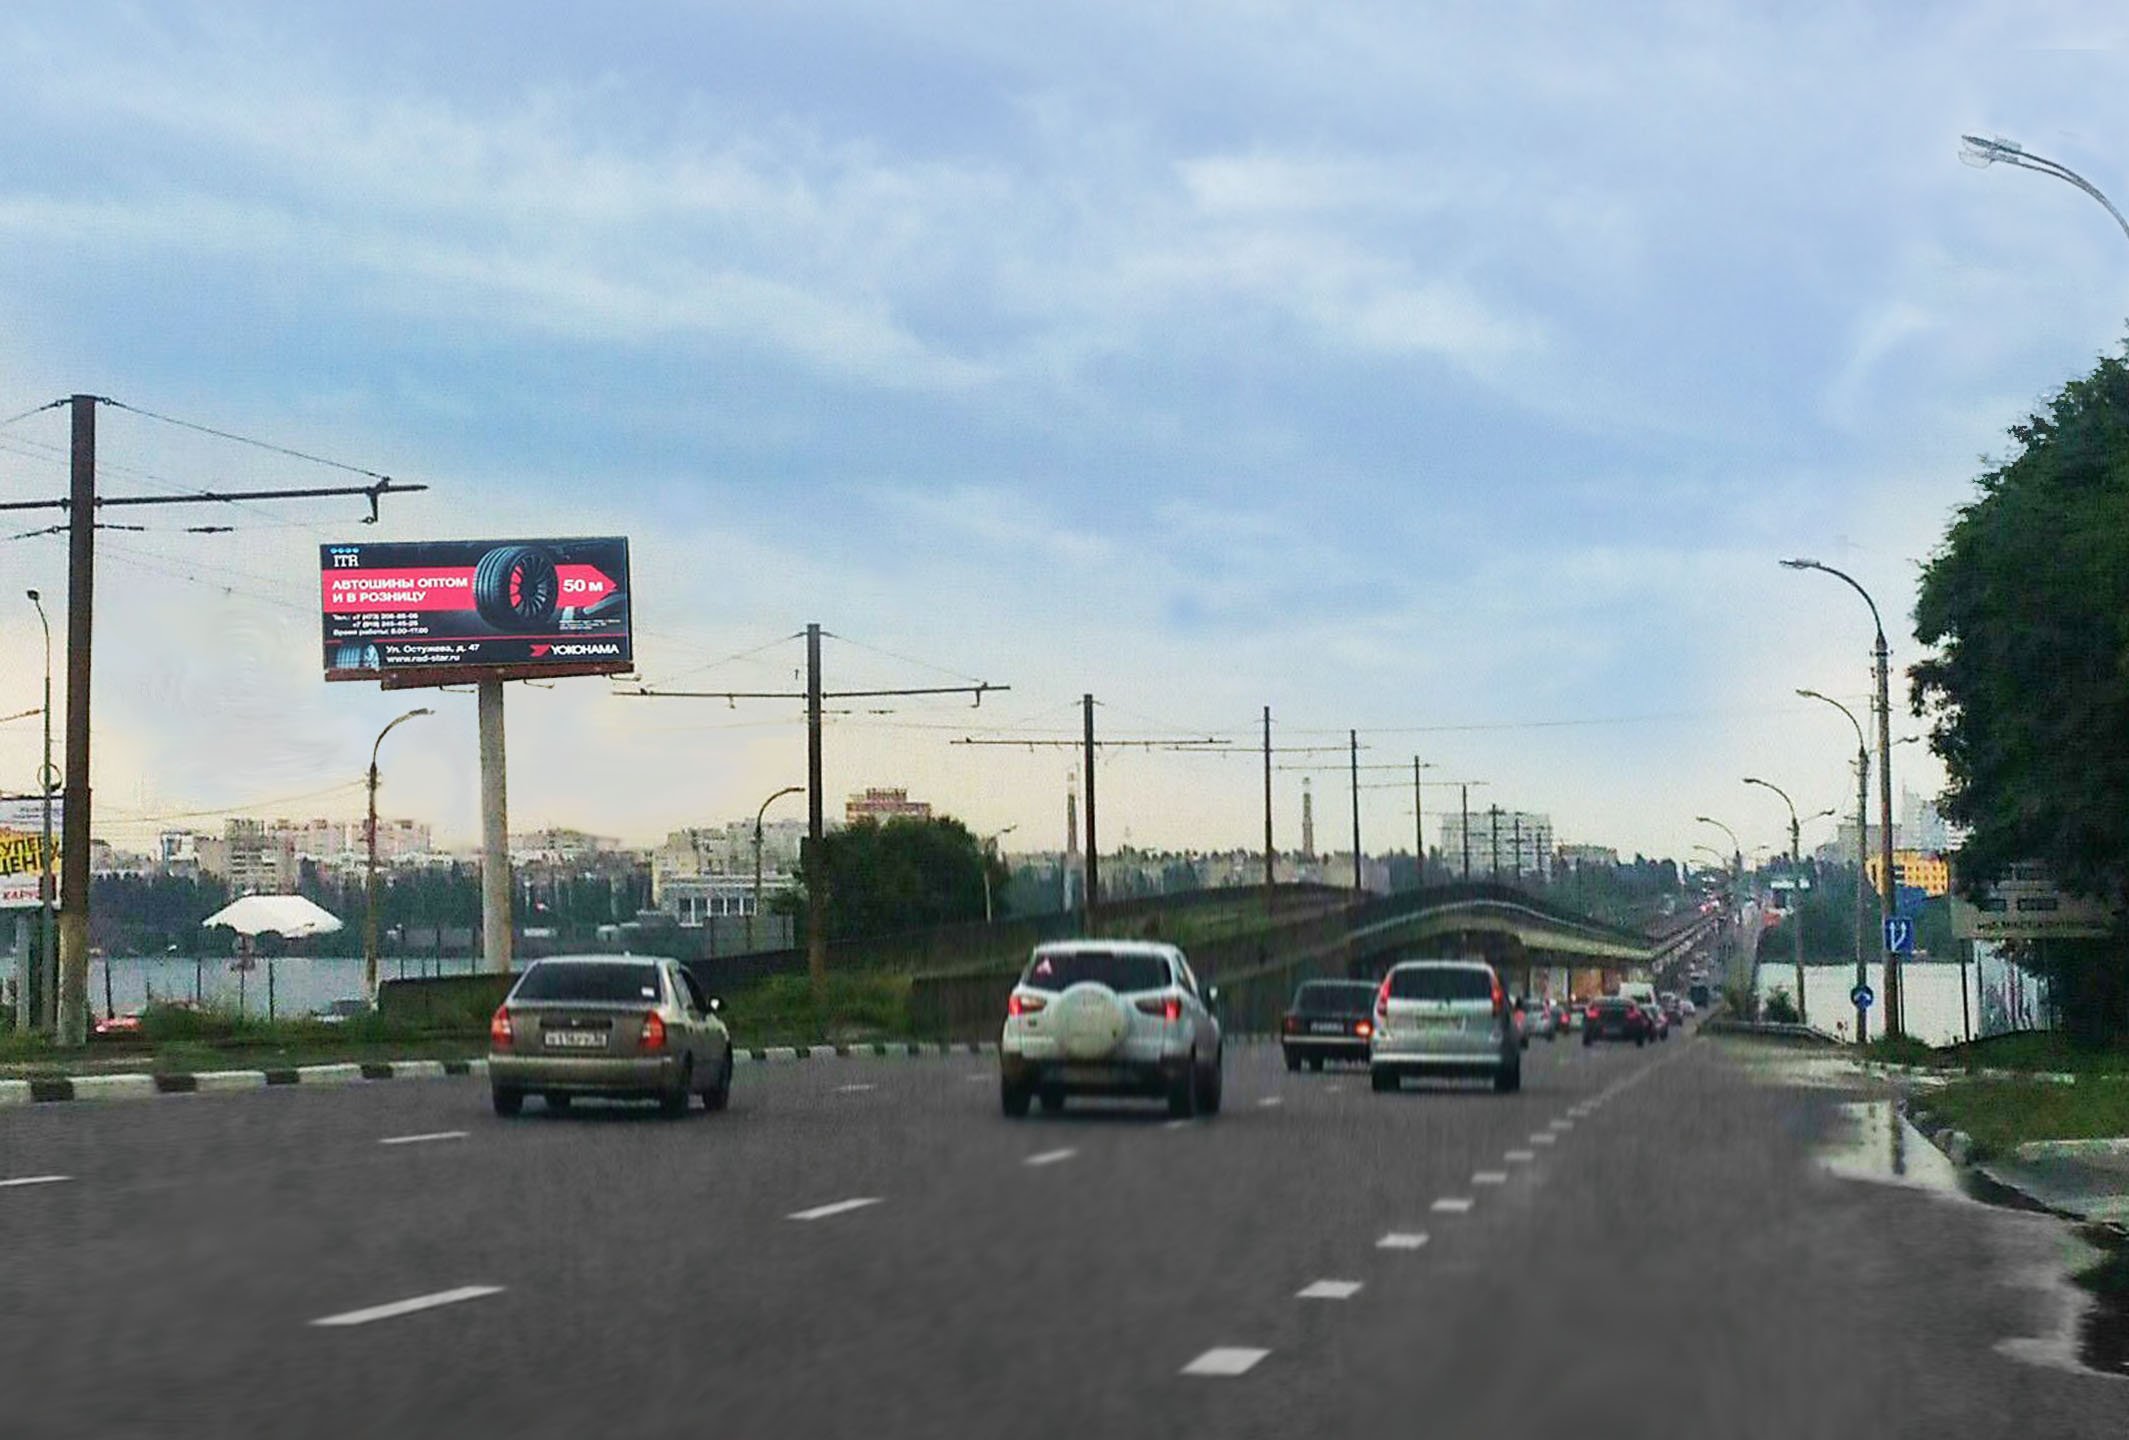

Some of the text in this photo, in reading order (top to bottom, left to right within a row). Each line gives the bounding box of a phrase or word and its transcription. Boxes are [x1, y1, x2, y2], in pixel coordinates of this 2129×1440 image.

[333, 555, 360, 567] ITR
[332, 577, 468, 590] АВТОШИНЫ ОПТОМ
[563, 579, 586, 592] 50
[332, 591, 427, 603] И В РОЗНИЦУ
[551, 644, 620, 655] YOKOHAMA
